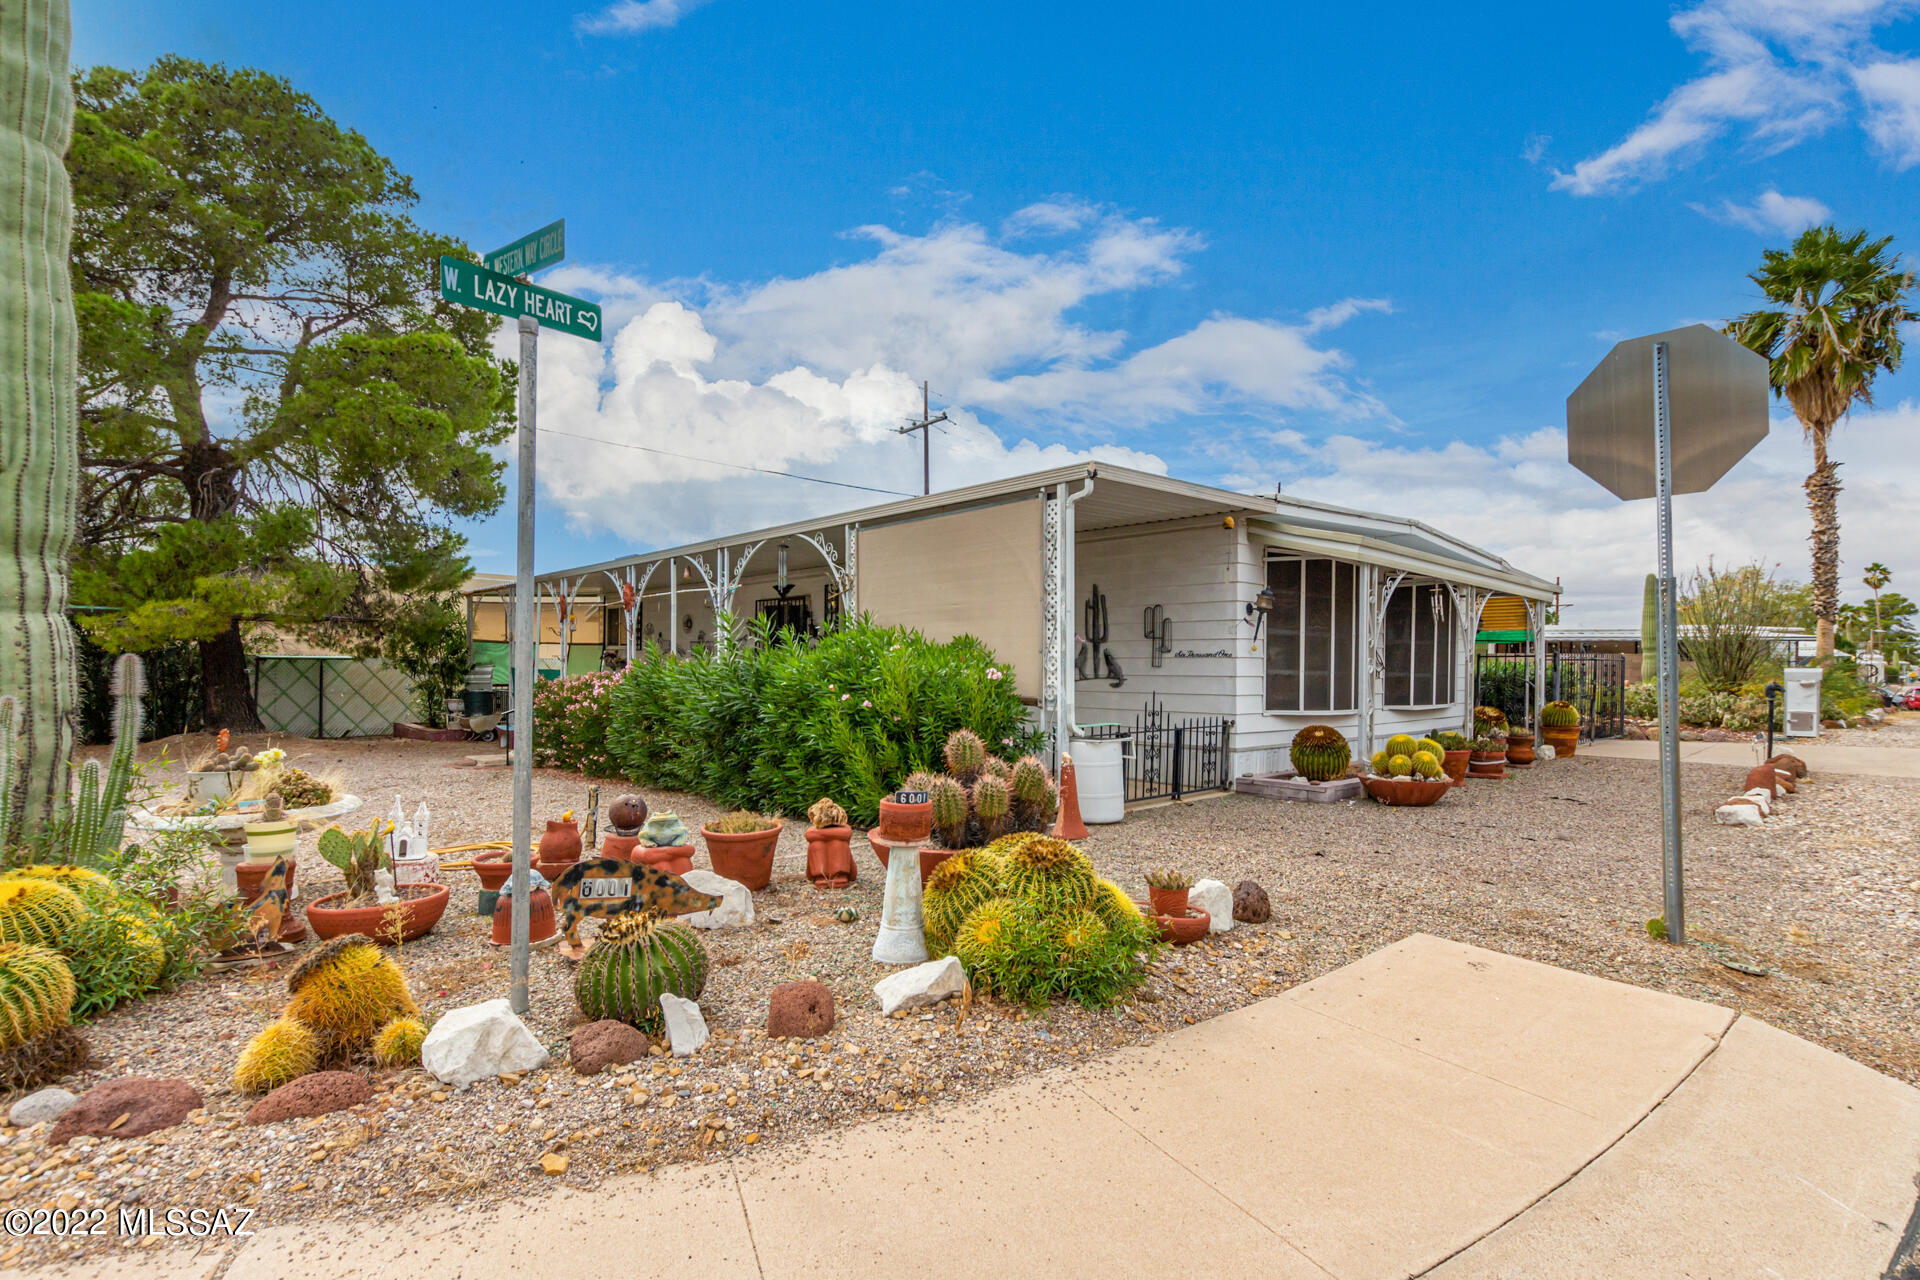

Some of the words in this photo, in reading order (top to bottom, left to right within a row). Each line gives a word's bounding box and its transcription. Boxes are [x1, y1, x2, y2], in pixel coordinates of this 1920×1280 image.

[494, 247, 523, 274] WESTERN
[525, 240, 538, 266] WAY
[539, 228, 563, 260] CIRCLE
[444, 265, 462, 293] W.
[474, 275, 517, 308] LAZY
[524, 290, 572, 325] HEART
[900, 793, 927, 803] 6001
